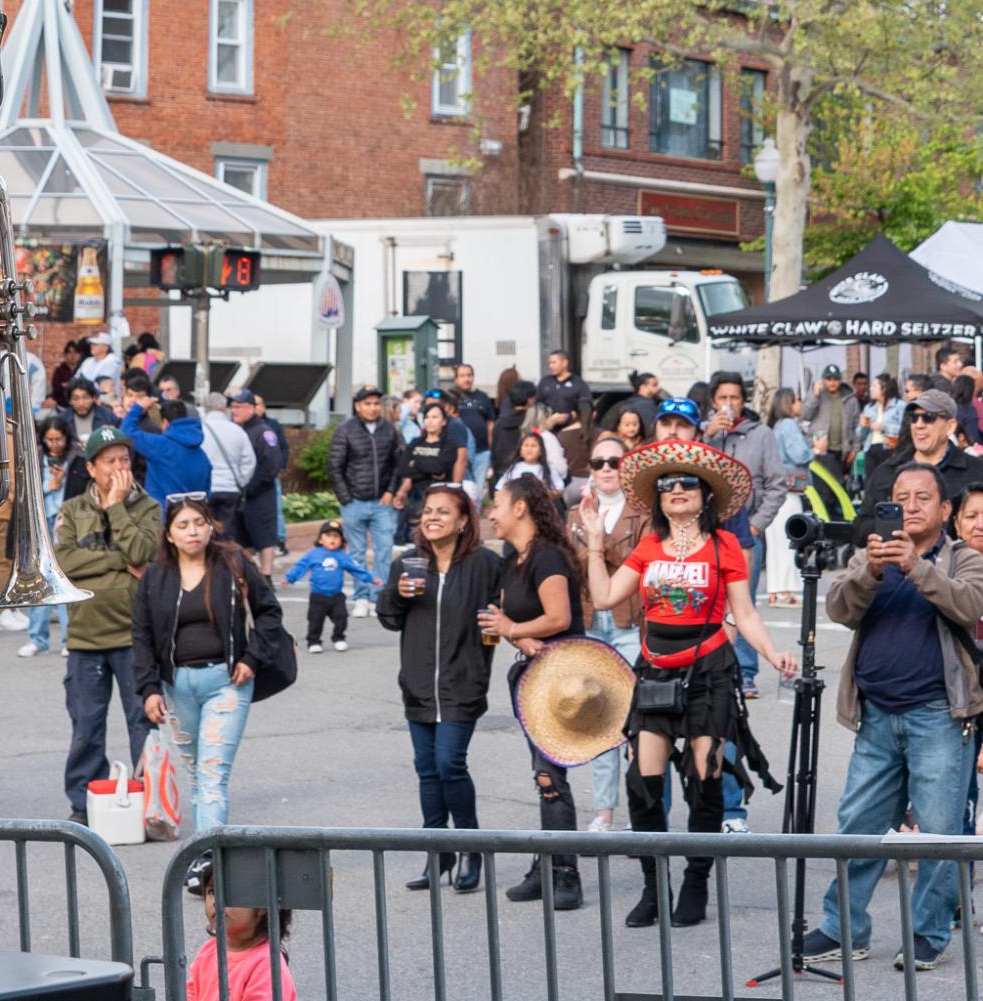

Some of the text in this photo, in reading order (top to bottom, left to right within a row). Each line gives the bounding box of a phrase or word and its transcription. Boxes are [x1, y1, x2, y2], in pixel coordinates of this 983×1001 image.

[236, 257, 251, 286] 8
[709, 320, 977, 338] WHITE CLAW HARD SELTZER
[644, 561, 707, 586] MARVEL
